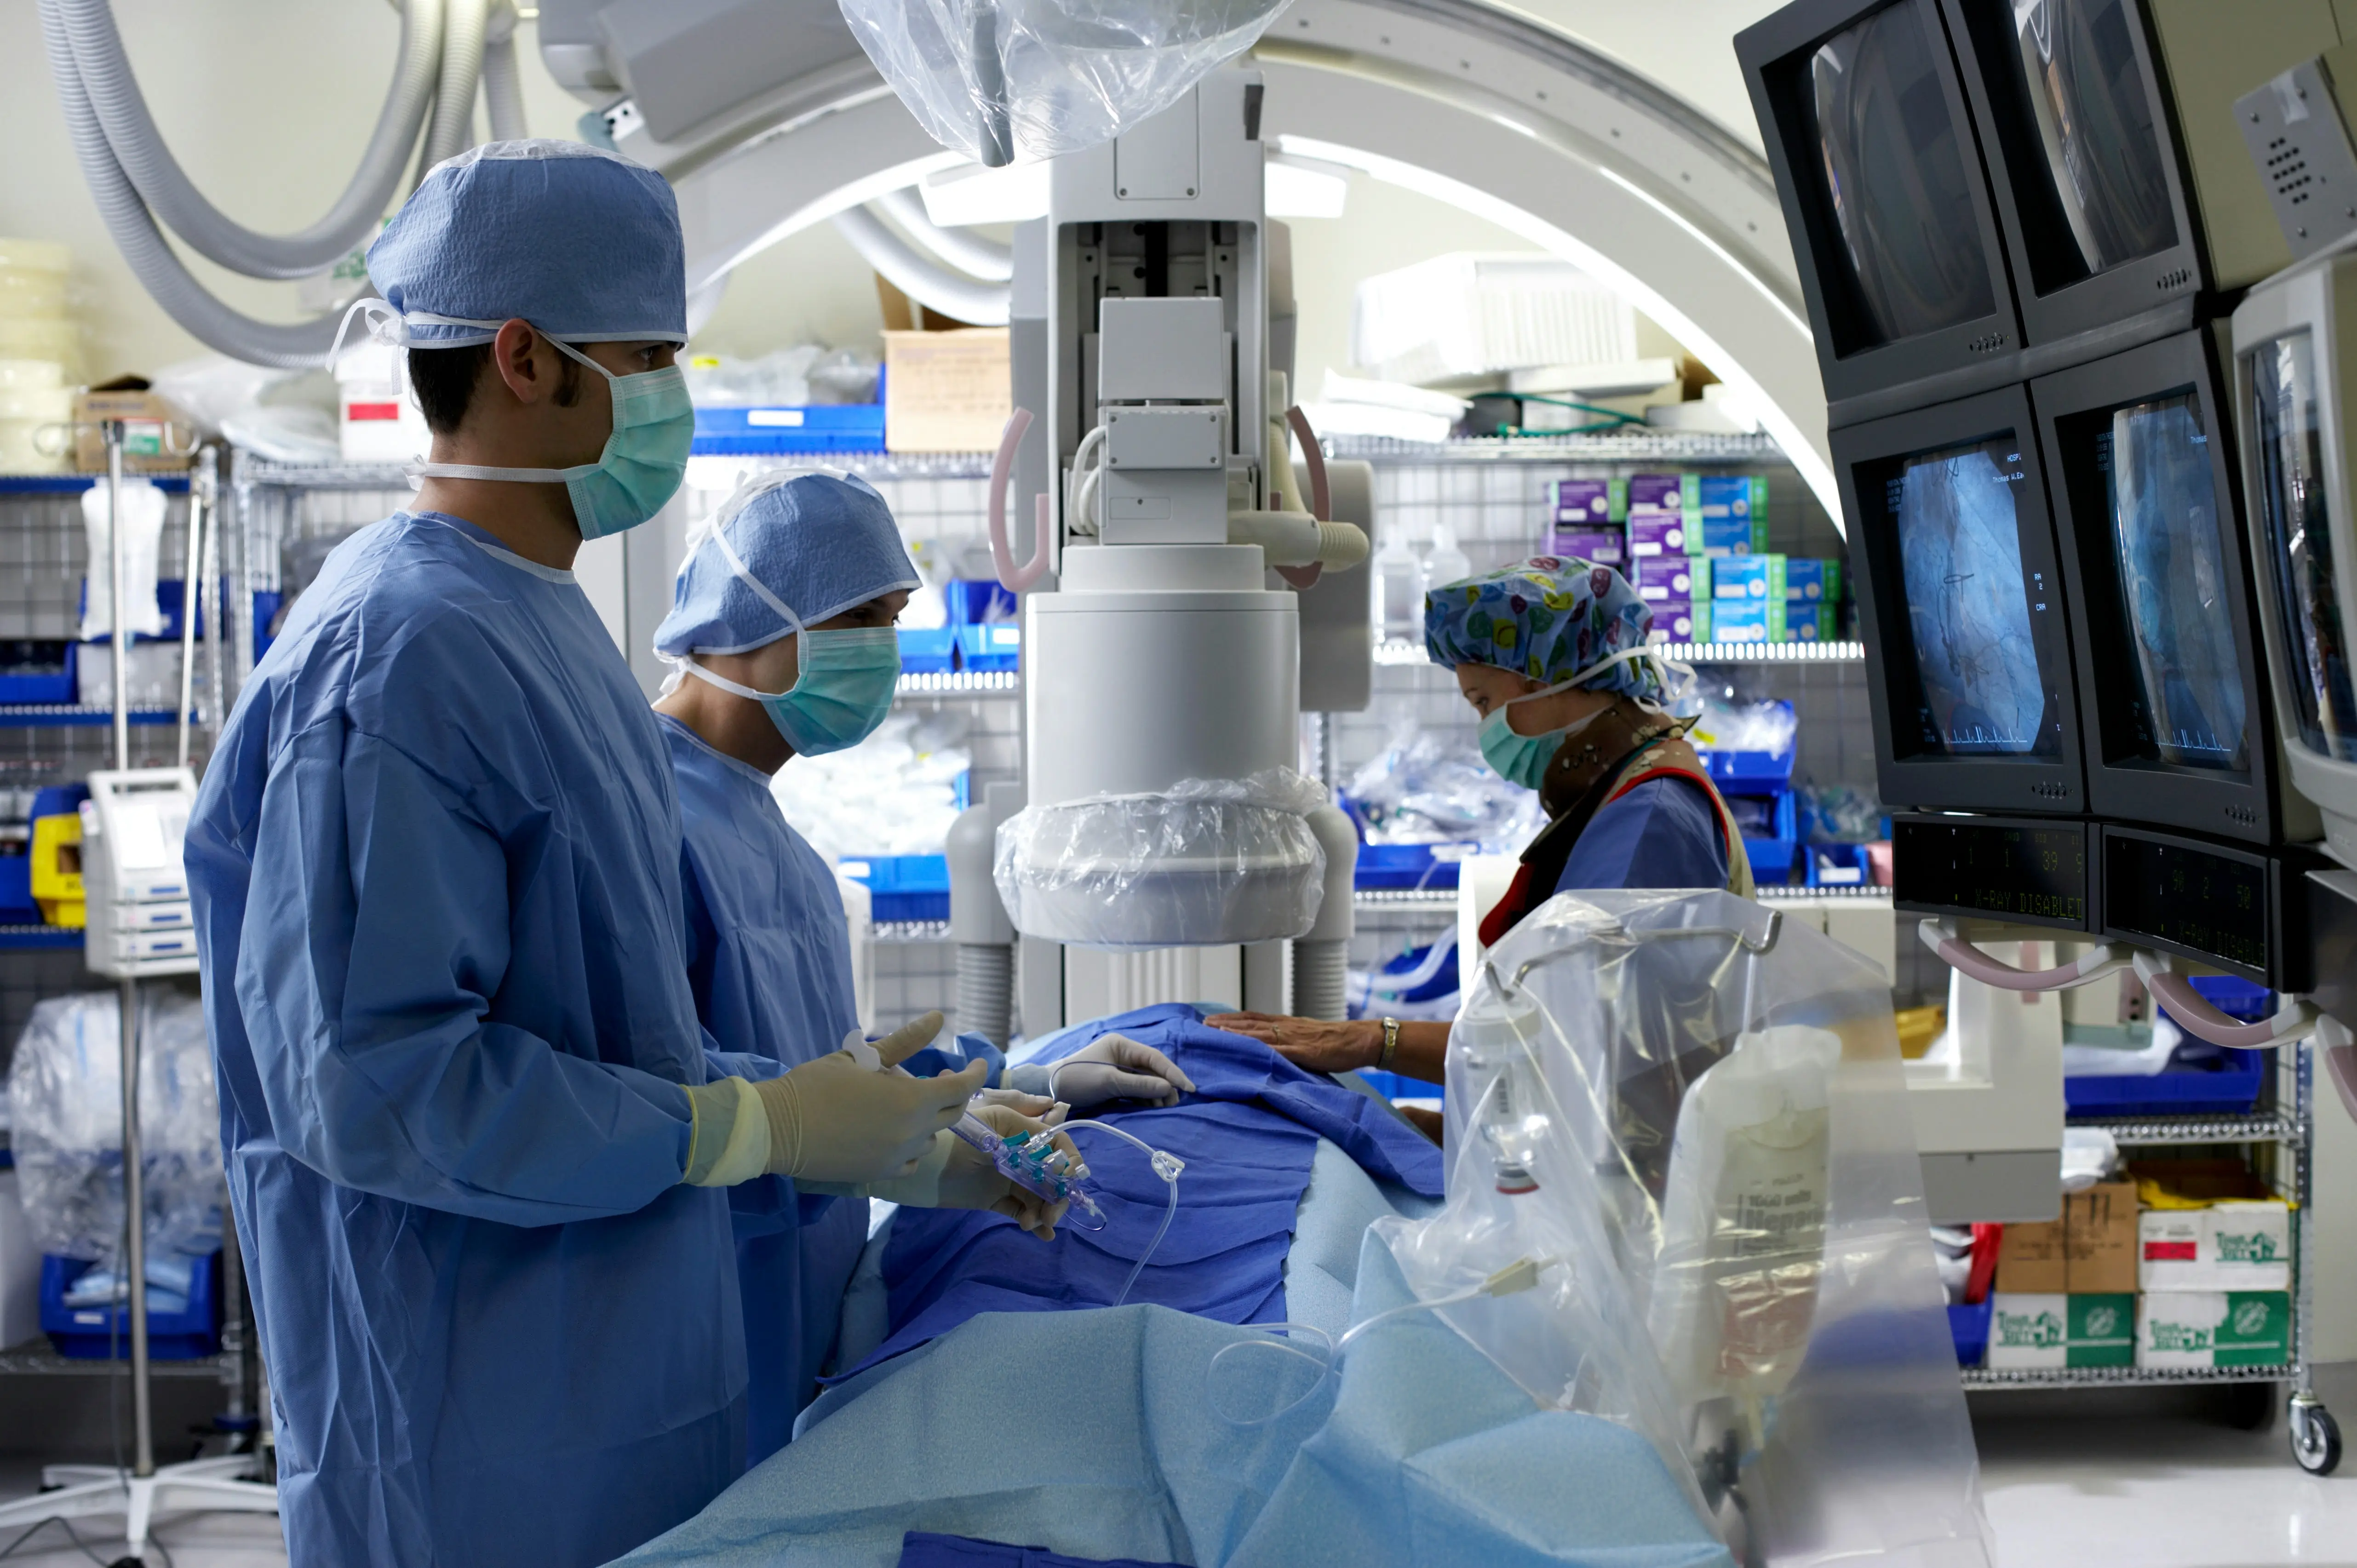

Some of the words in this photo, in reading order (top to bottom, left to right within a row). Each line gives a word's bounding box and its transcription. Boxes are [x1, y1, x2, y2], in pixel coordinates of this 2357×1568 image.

[2042, 850, 2058, 871] 39
[1975, 888, 2011, 911] X-RAY
[2178, 920, 2210, 950] X-RAY
